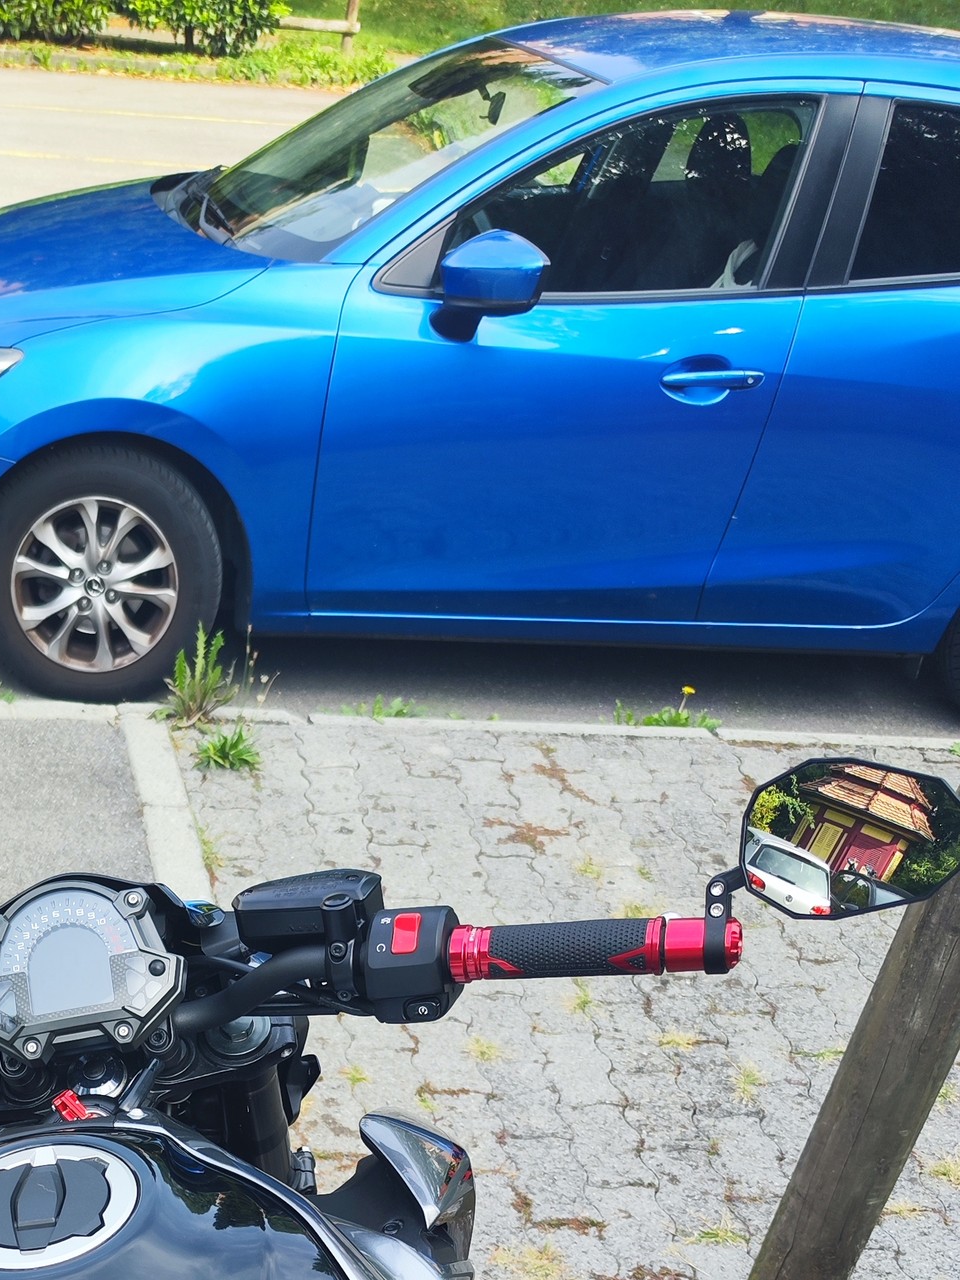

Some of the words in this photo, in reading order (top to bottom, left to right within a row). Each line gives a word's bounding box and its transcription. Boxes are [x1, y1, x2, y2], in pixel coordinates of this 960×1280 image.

[52, 910, 60, 918] 6
[64, 908, 72, 916] 7
[76, 908, 84, 916] 8
[87, 912, 95, 920] 9
[41, 915, 49, 923] 5
[96, 918, 106, 926] 10
[23, 931, 30, 940] 3
[17, 942, 25, 950] 2
[14, 954, 20, 962] 1
[12, 964, 20, 972] 0
